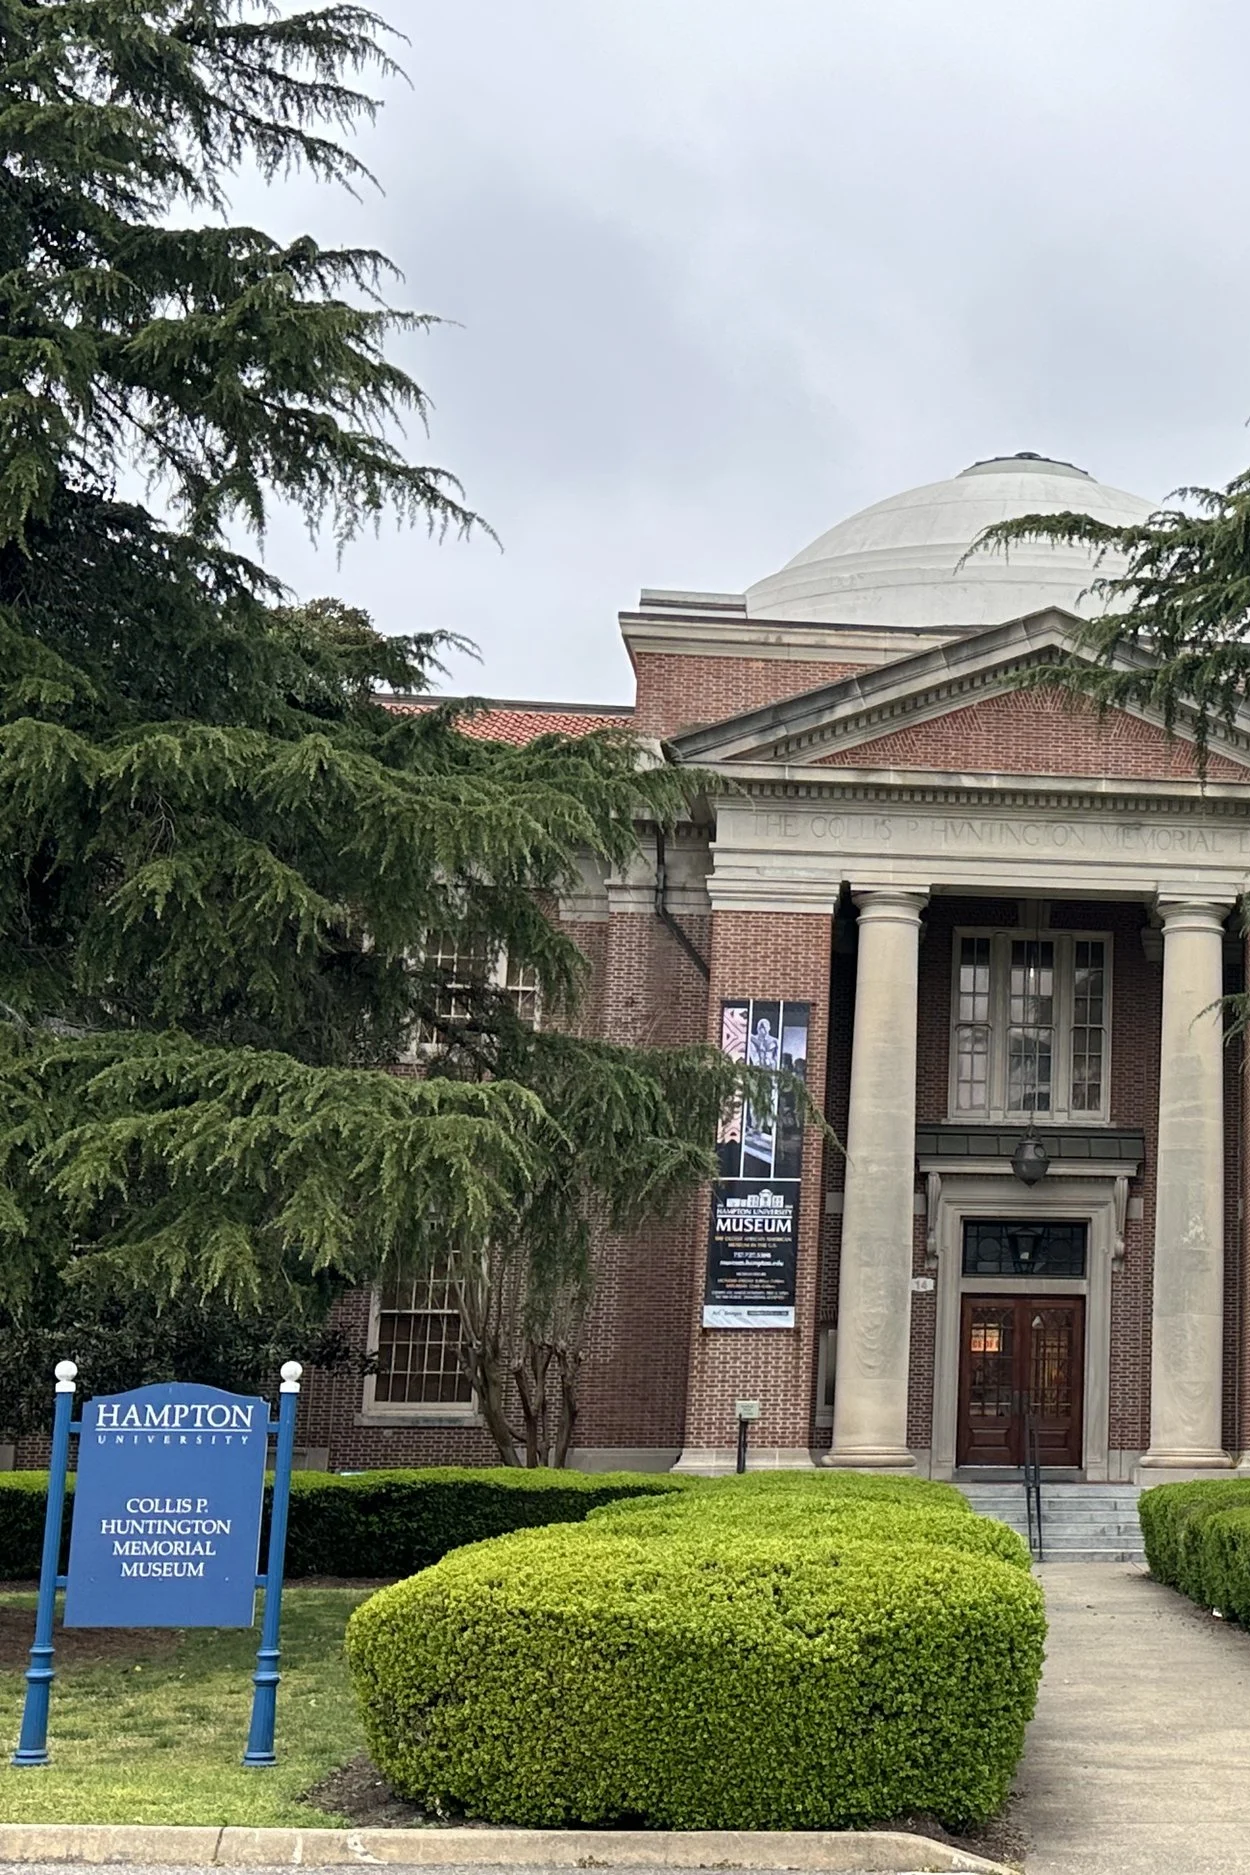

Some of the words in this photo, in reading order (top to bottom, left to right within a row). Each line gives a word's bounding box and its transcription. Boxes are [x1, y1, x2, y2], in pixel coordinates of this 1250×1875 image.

[749, 812, 799, 838] THE
[809, 815, 893, 841] COLLIS
[1096, 825, 1224, 853] MEMORIAL
[716, 1218, 792, 1233] MUSEUM
[95, 1403, 254, 1428] HAMPTON
[98, 1434, 249, 1445] UNIVERSITY
[126, 1498, 192, 1514] COLLIS
[195, 1498, 209, 1514] P.
[101, 1518, 232, 1535] HUNTINGTON
[112, 1540, 216, 1556] MEMORIAL
[120, 1561, 204, 1577] MUSEUM
